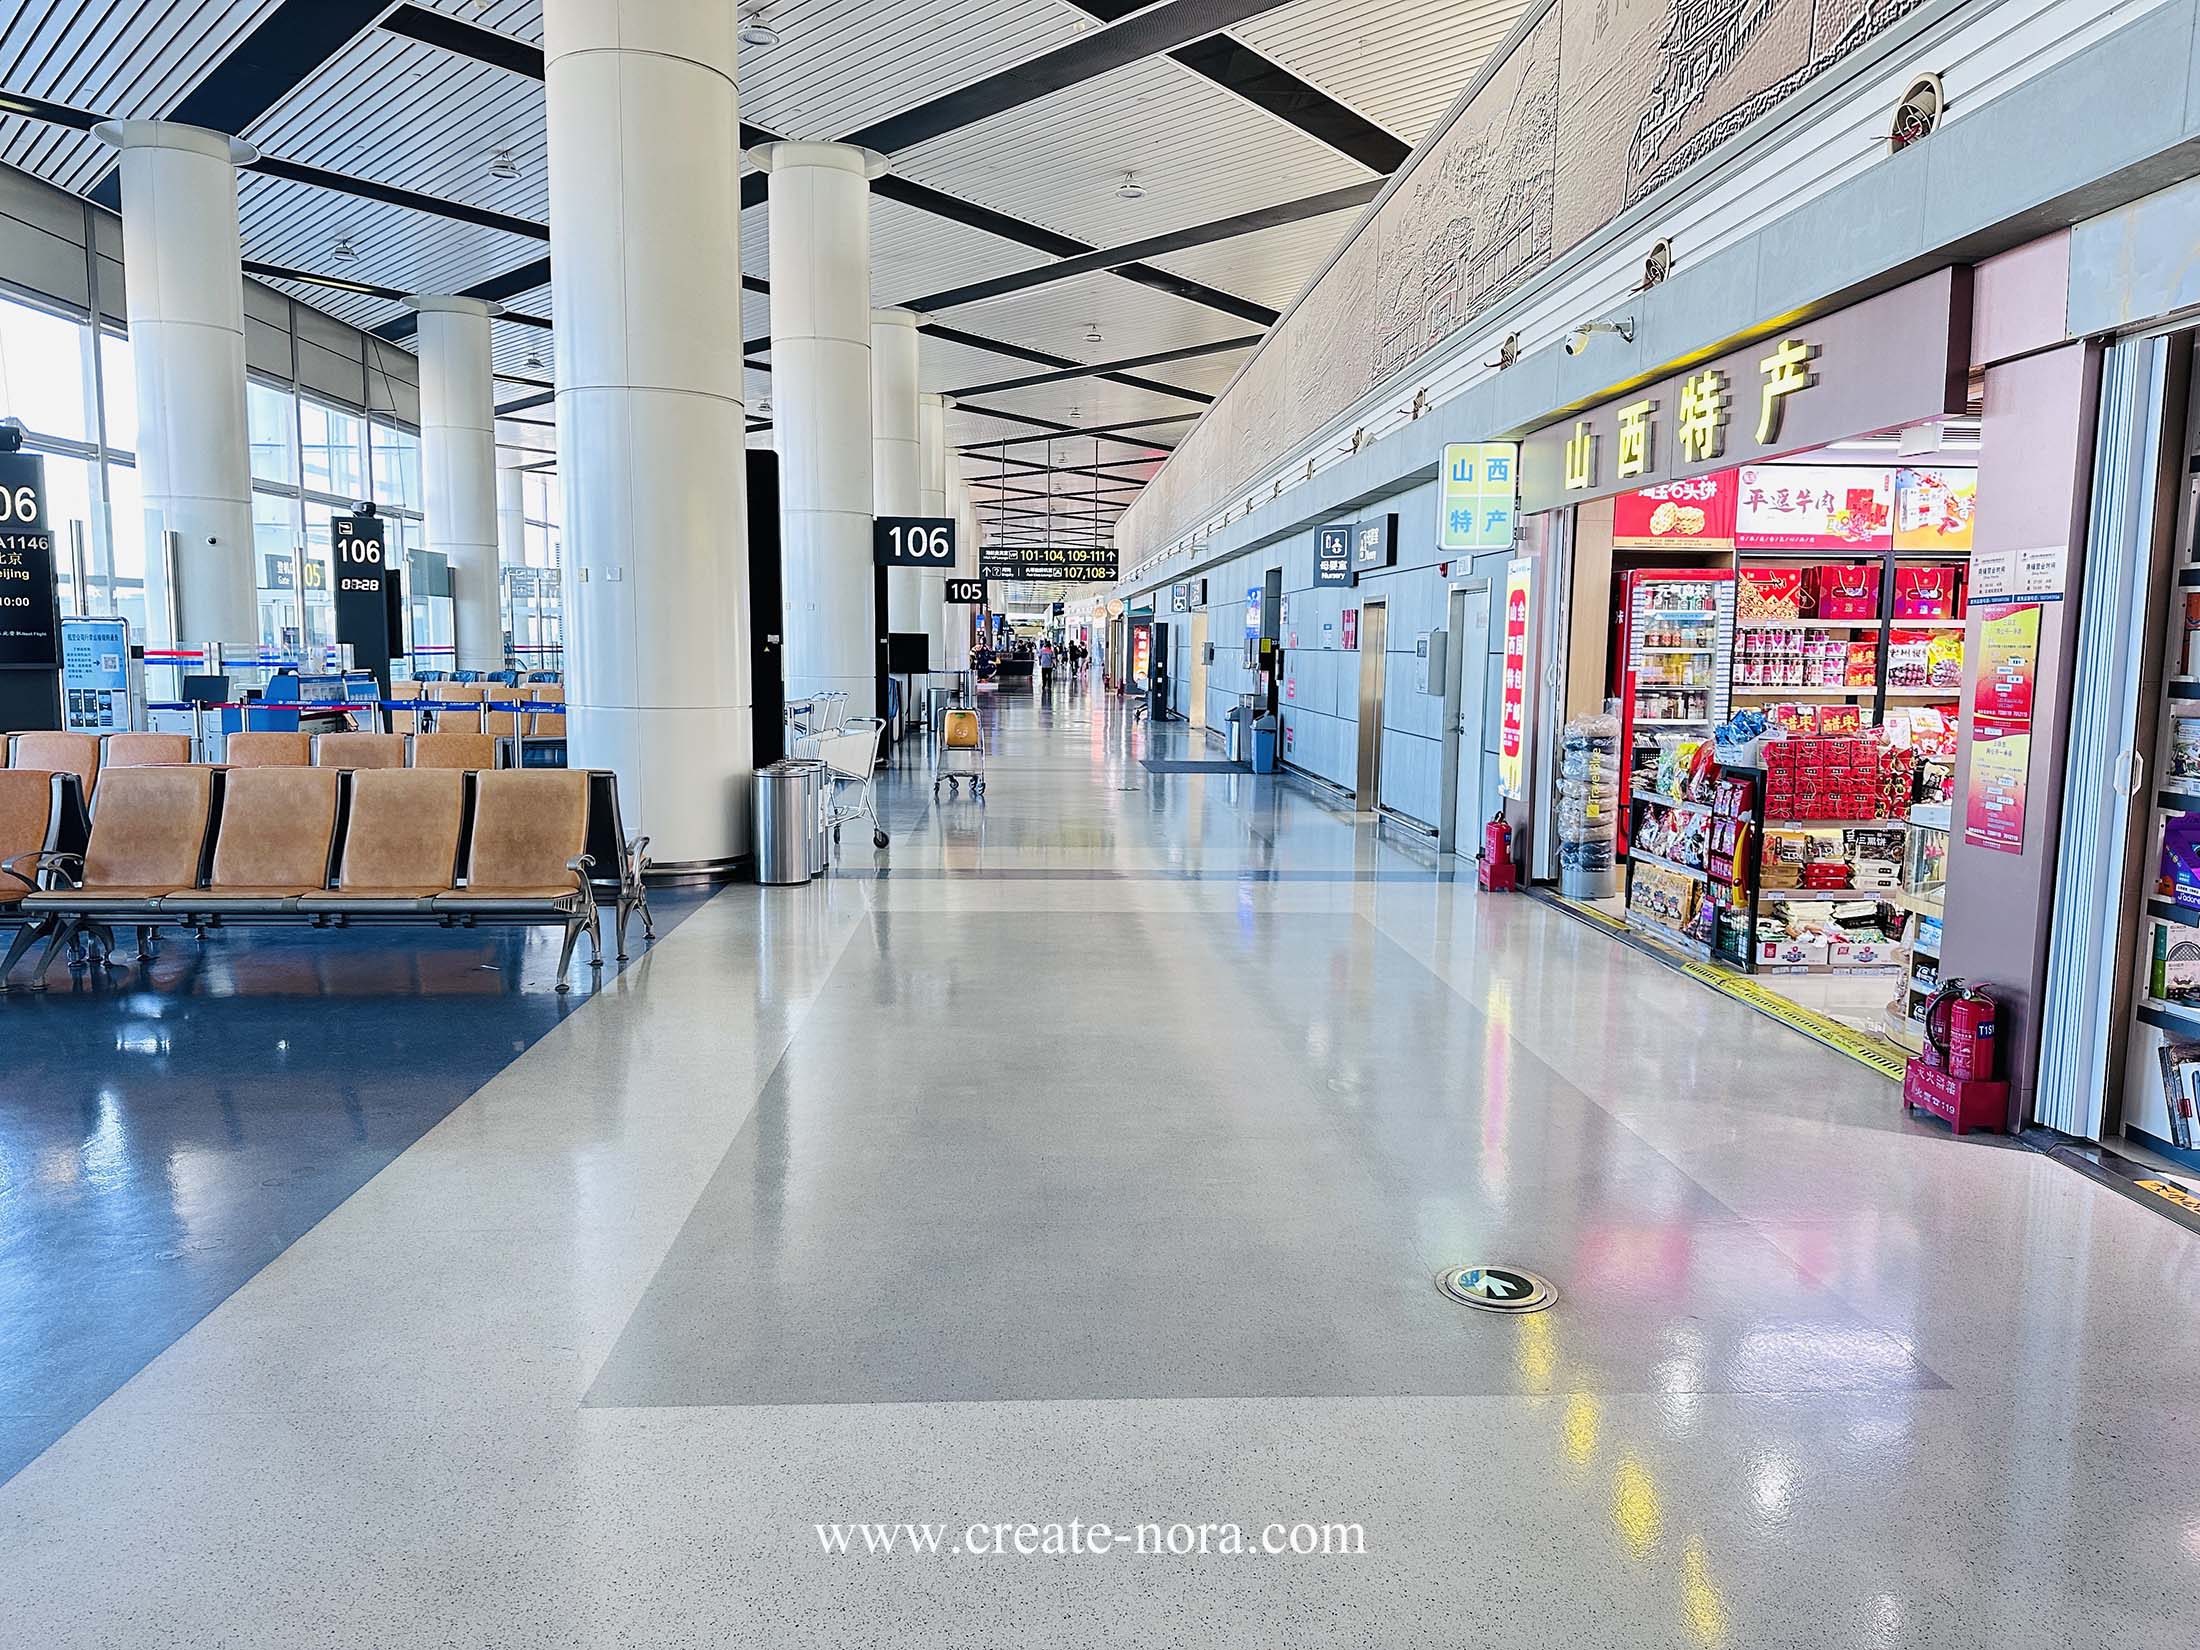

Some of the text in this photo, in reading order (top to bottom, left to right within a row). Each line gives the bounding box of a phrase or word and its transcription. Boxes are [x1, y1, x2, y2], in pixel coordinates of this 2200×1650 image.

[1565, 339, 1812, 490] 山西特产
[1453, 459, 1510, 481] 山西
[1743, 488, 1836, 514] 平遥牛肉
[1450, 509, 1508, 533] 特产
[338, 539, 380, 563] 106
[889, 527, 949, 557] 106
[1067, 550, 1105, 562] 109-111
[1320, 560, 1348, 571] 母婴室
[278, 576, 290, 585] Gate
[304, 563, 321, 587] 05
[1063, 567, 1106, 580] 107,108
[1321, 572, 1346, 580] Nursery
[951, 583, 982, 600] 105
[1823, 715, 1860, 732] 醋枣
